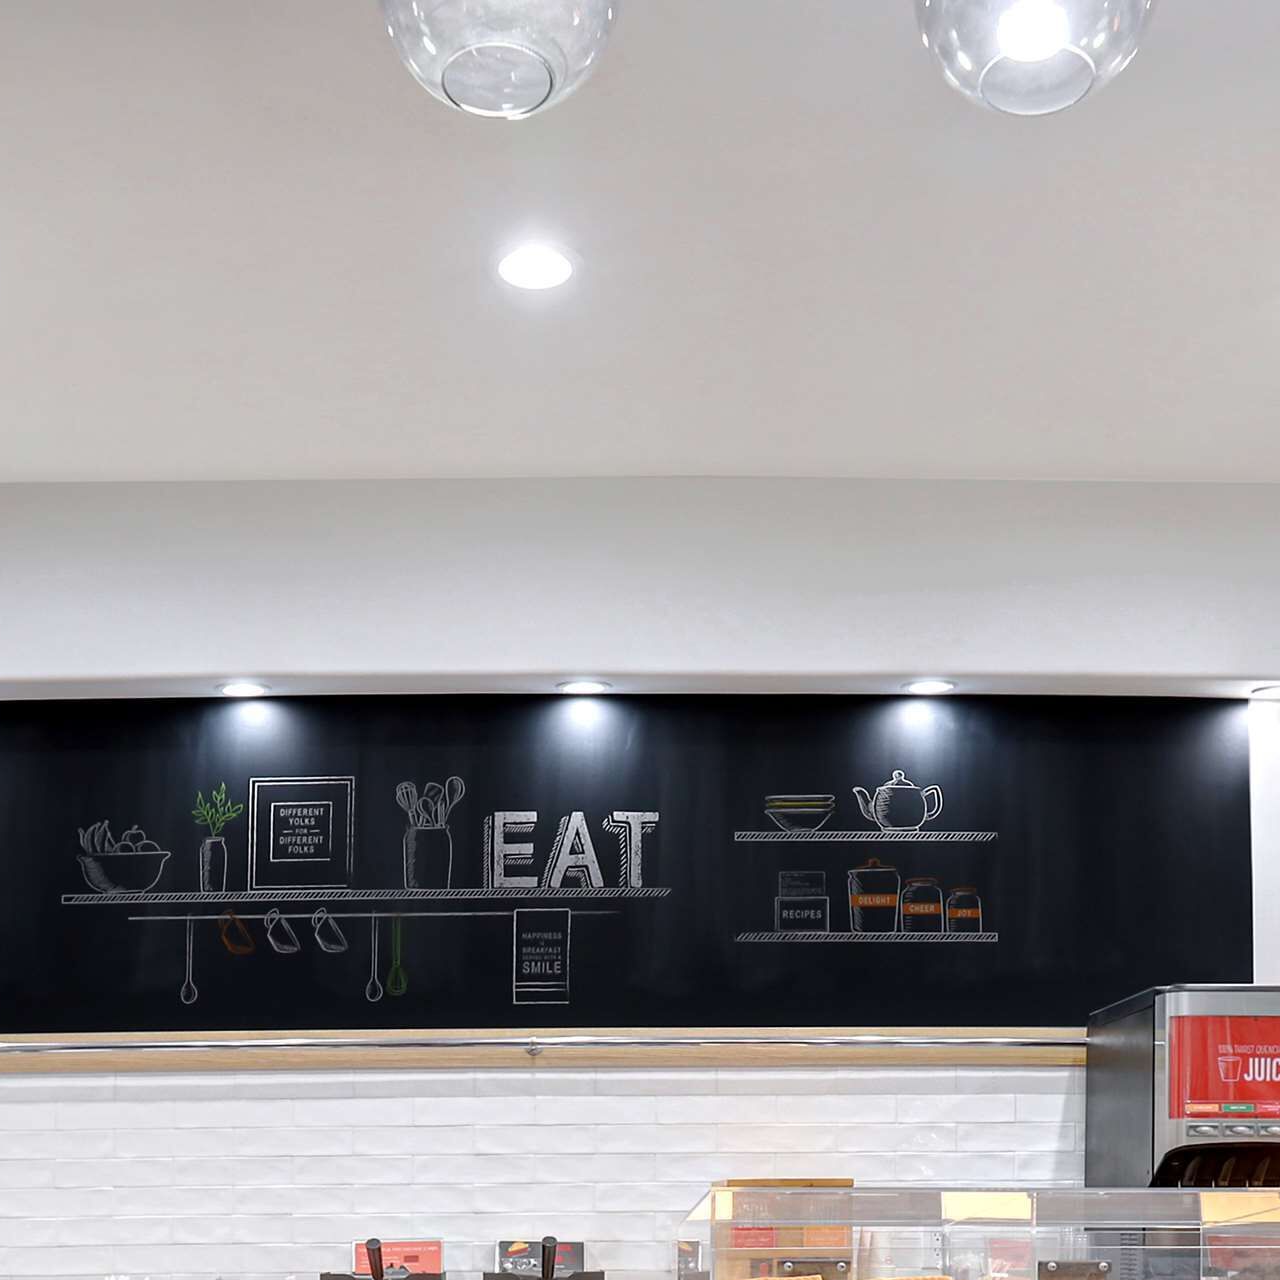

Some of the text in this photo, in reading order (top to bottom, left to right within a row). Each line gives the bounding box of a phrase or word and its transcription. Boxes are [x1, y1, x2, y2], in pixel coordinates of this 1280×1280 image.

[279, 807, 325, 817] DIFFERENT
[288, 817, 316, 826] YOLKS
[279, 835, 324, 845] DIFFERENT
[287, 845, 315, 854] FOLKS
[483, 811, 660, 889] EAT
[858, 895, 891, 906] DELIGHT
[908, 904, 936, 913] CHEER
[781, 908, 823, 920] RECIPES
[522, 946, 561, 954] BREAKFAST
[522, 961, 562, 974] SMILE
